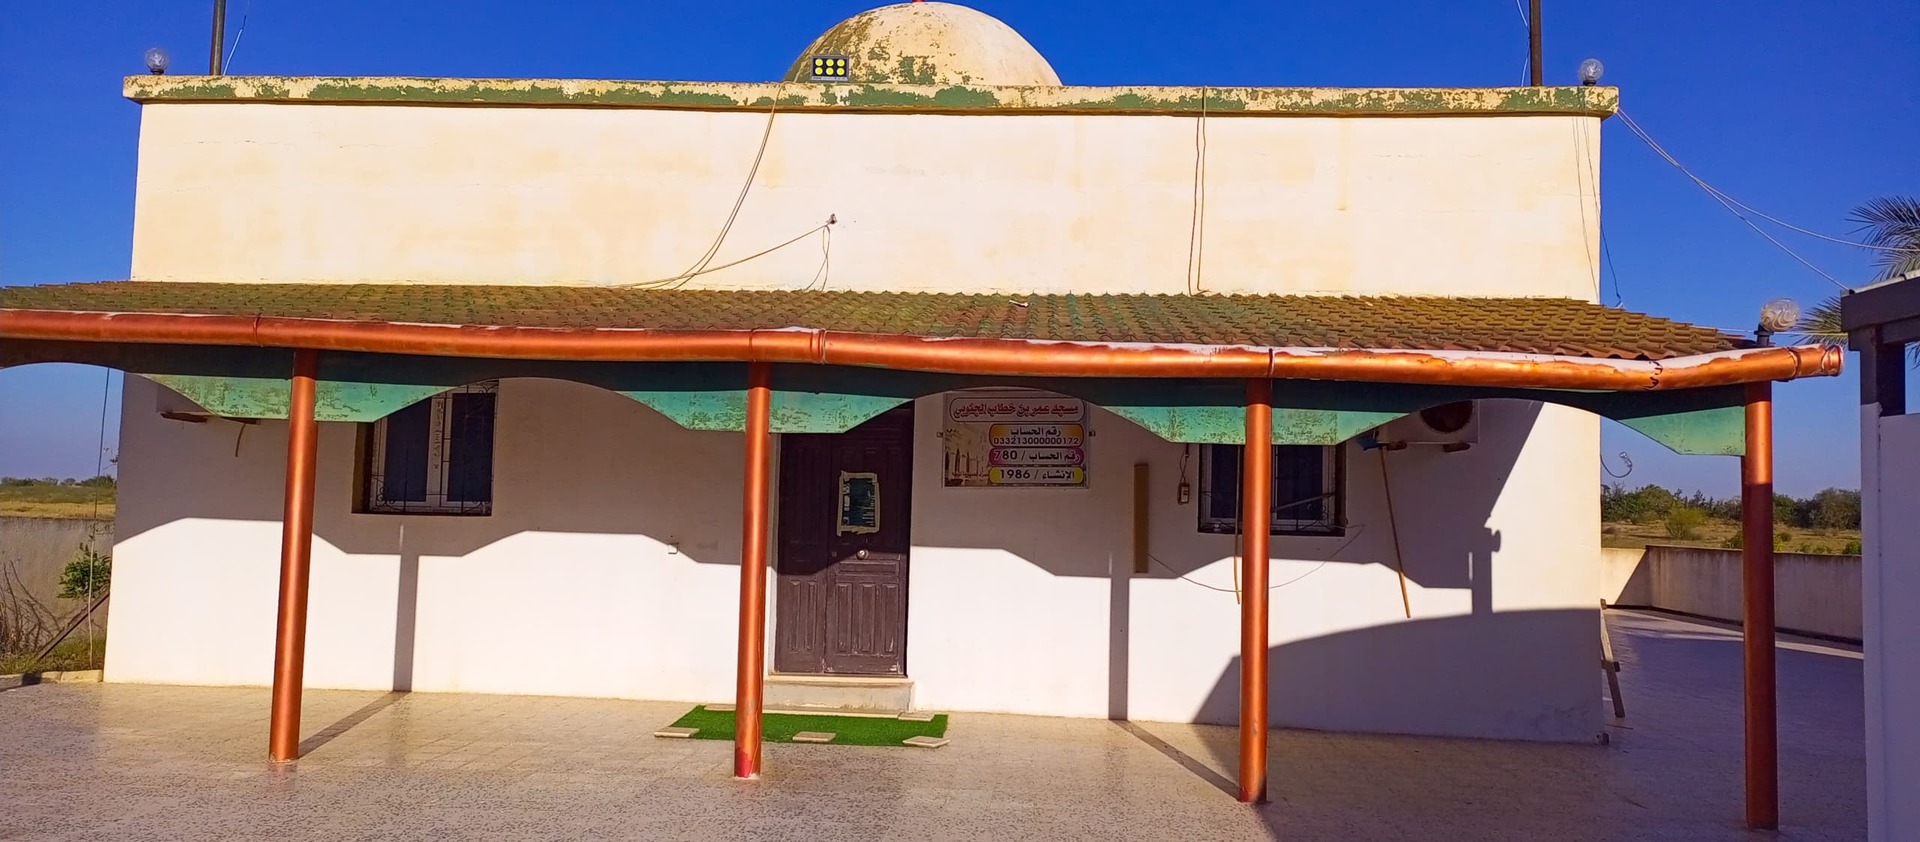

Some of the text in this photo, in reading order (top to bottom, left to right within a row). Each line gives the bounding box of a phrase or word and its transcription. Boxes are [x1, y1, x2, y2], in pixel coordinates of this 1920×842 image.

[989, 402, 1016, 417] خطاب
[1016, 403, 1029, 417] بن
[1031, 404, 1049, 417] عمر
[1051, 403, 1078, 417] مسجد
[1010, 426, 1061, 437] رقم الحساب
[993, 437, 1079, 445] 033213000000172
[993, 450, 1018, 460] 780
[1029, 451, 1062, 462] الحساب
[1063, 451, 1080, 461] رقم
[1000, 469, 1031, 480] 1986
[1042, 469, 1075, 480] الإنشاء
